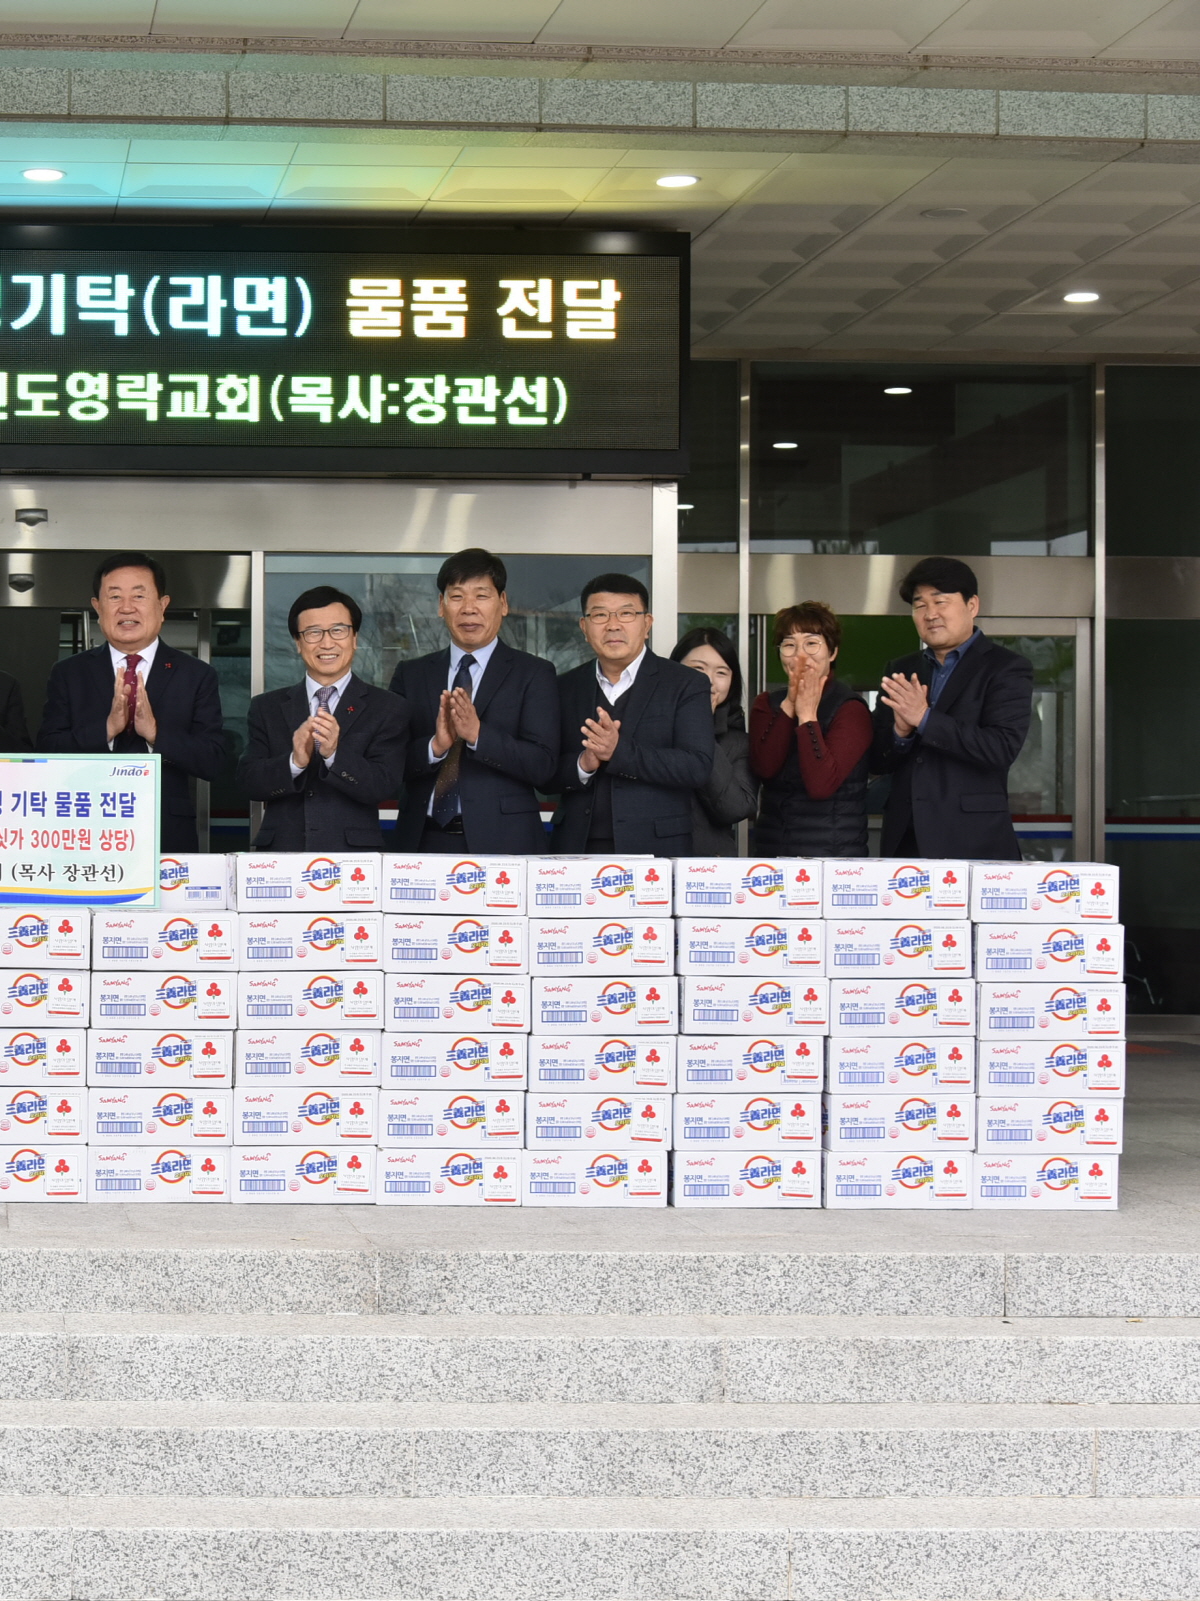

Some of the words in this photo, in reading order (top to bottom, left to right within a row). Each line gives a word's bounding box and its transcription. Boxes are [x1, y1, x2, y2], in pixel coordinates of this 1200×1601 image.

[346, 278, 469, 338] 물품
[496, 278, 622, 340] 전달
[109, 766, 143, 777] Jindo
[10, 790, 48, 818] 기탁
[54, 791, 92, 818] 물품
[99, 791, 137, 818] 전달
[31, 828, 92, 851] 300만원
[98, 829, 136, 852] 상당)
[11, 862, 56, 883] (목사
[62, 863, 125, 883] 장관선)
[390, 878, 410, 888] 봉지면
[685, 882, 705, 892] 봉지면
[981, 887, 1001, 897] 봉지면
[246, 936, 266, 946] 봉지면
[537, 942, 557, 952] 봉지면
[834, 943, 854, 953] 봉지면
[100, 994, 120, 1004] 봉지면
[393, 996, 413, 1006] 봉지면
[693, 999, 713, 1009] 봉지면
[538, 1058, 558, 1068] 봉지면
[838, 1061, 858, 1071] 봉지면
[96, 1111, 116, 1121] 봉지면
[387, 1113, 407, 1123] 봉지면
[683, 1116, 703, 1126] 봉지면
[986, 1119, 1006, 1129] 봉지면
[239, 1169, 259, 1179] 봉지면
[529, 1171, 549, 1181] 봉지면
[835, 1174, 855, 1184] 봉지면
